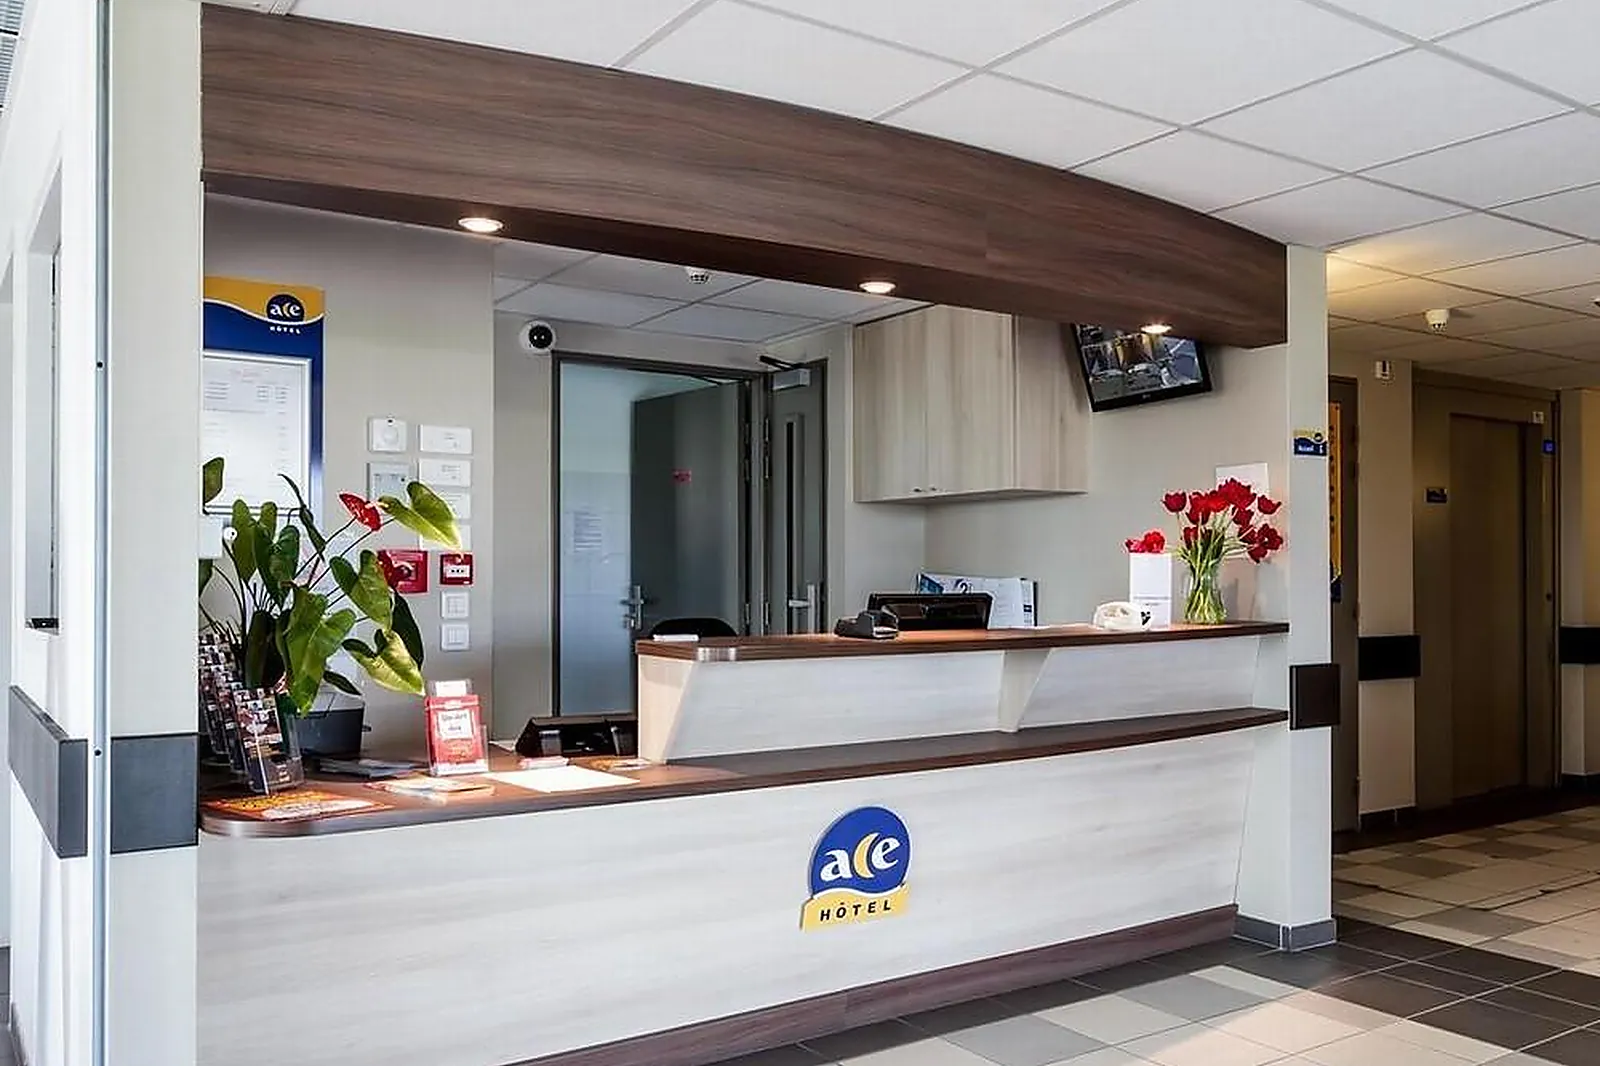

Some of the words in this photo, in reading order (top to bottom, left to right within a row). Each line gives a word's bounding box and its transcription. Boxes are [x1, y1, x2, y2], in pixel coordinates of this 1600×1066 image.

[270, 302, 301, 317] ace
[820, 832, 900, 881] ace
[820, 899, 892, 922] HÔTEL
